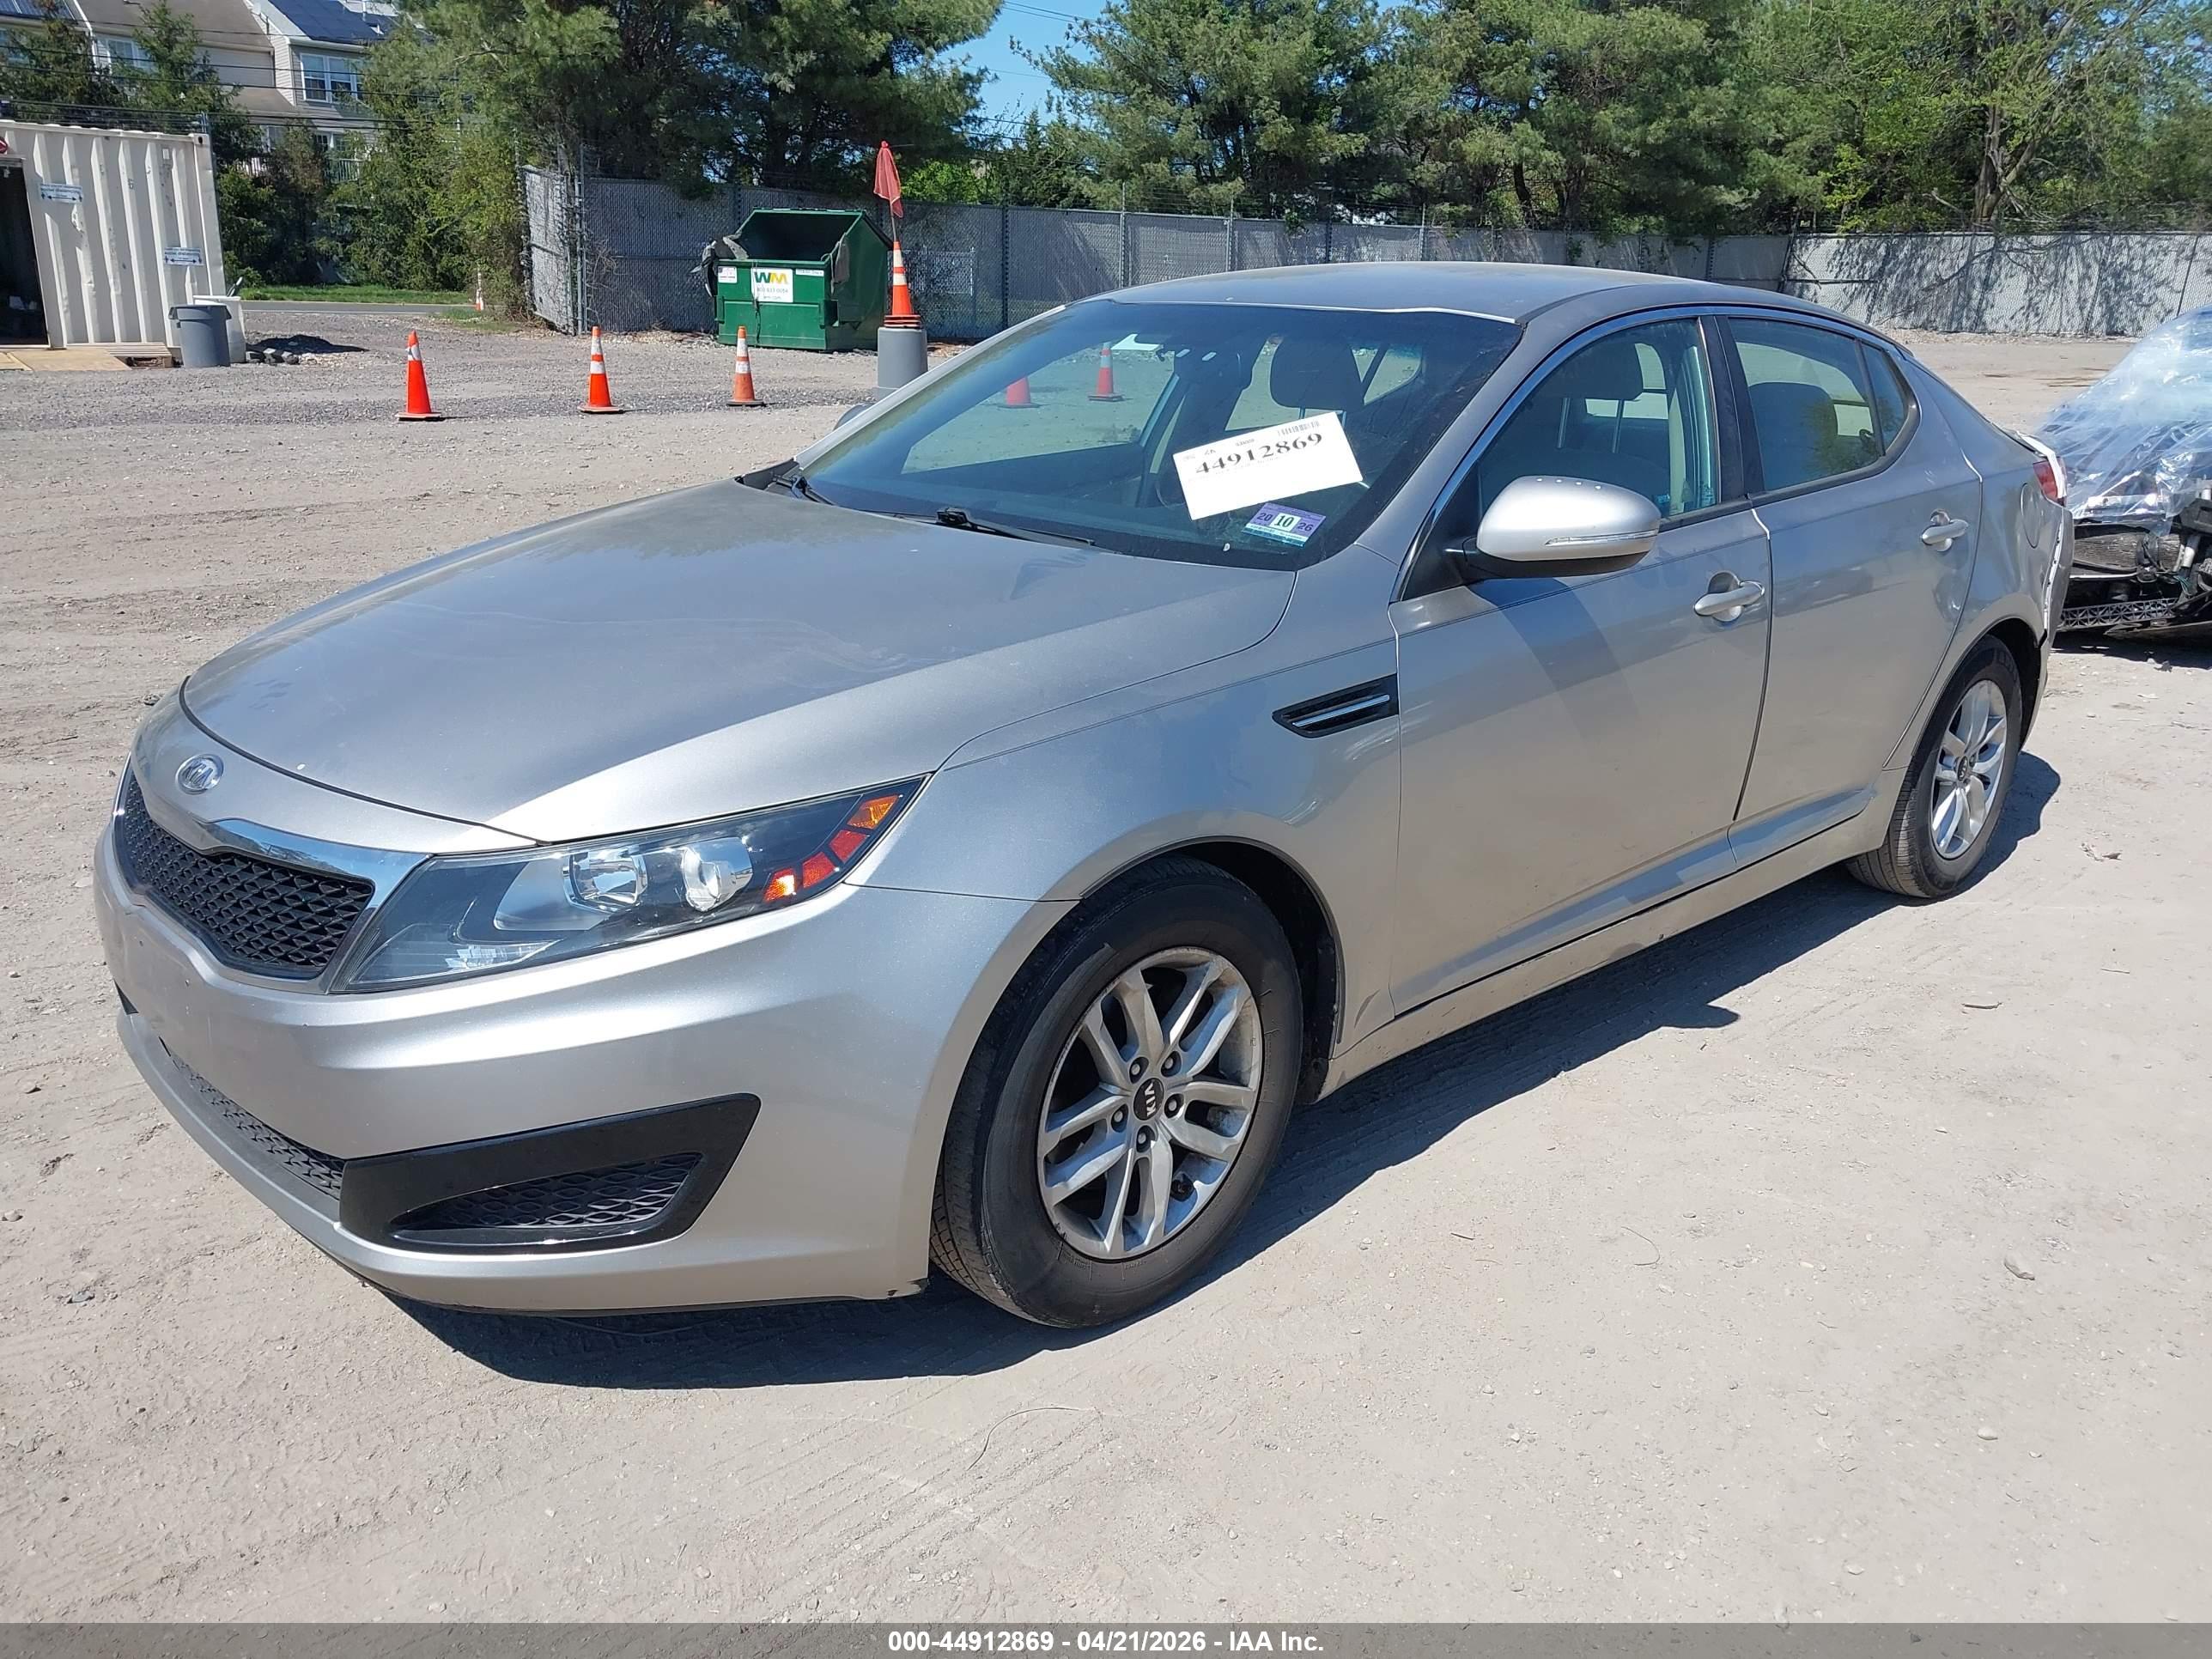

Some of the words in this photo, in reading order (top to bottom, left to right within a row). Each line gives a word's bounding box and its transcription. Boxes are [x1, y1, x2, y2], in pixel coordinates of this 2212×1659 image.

[755, 271, 788, 284] WM
[1196, 433, 1322, 473] 44912869
[1256, 513, 1273, 521] 20
[1273, 515, 1295, 528] 10
[1297, 522, 1314, 532] 26
[181, 763, 214, 787] KIA
[1145, 1082, 1156, 1116] KIA
